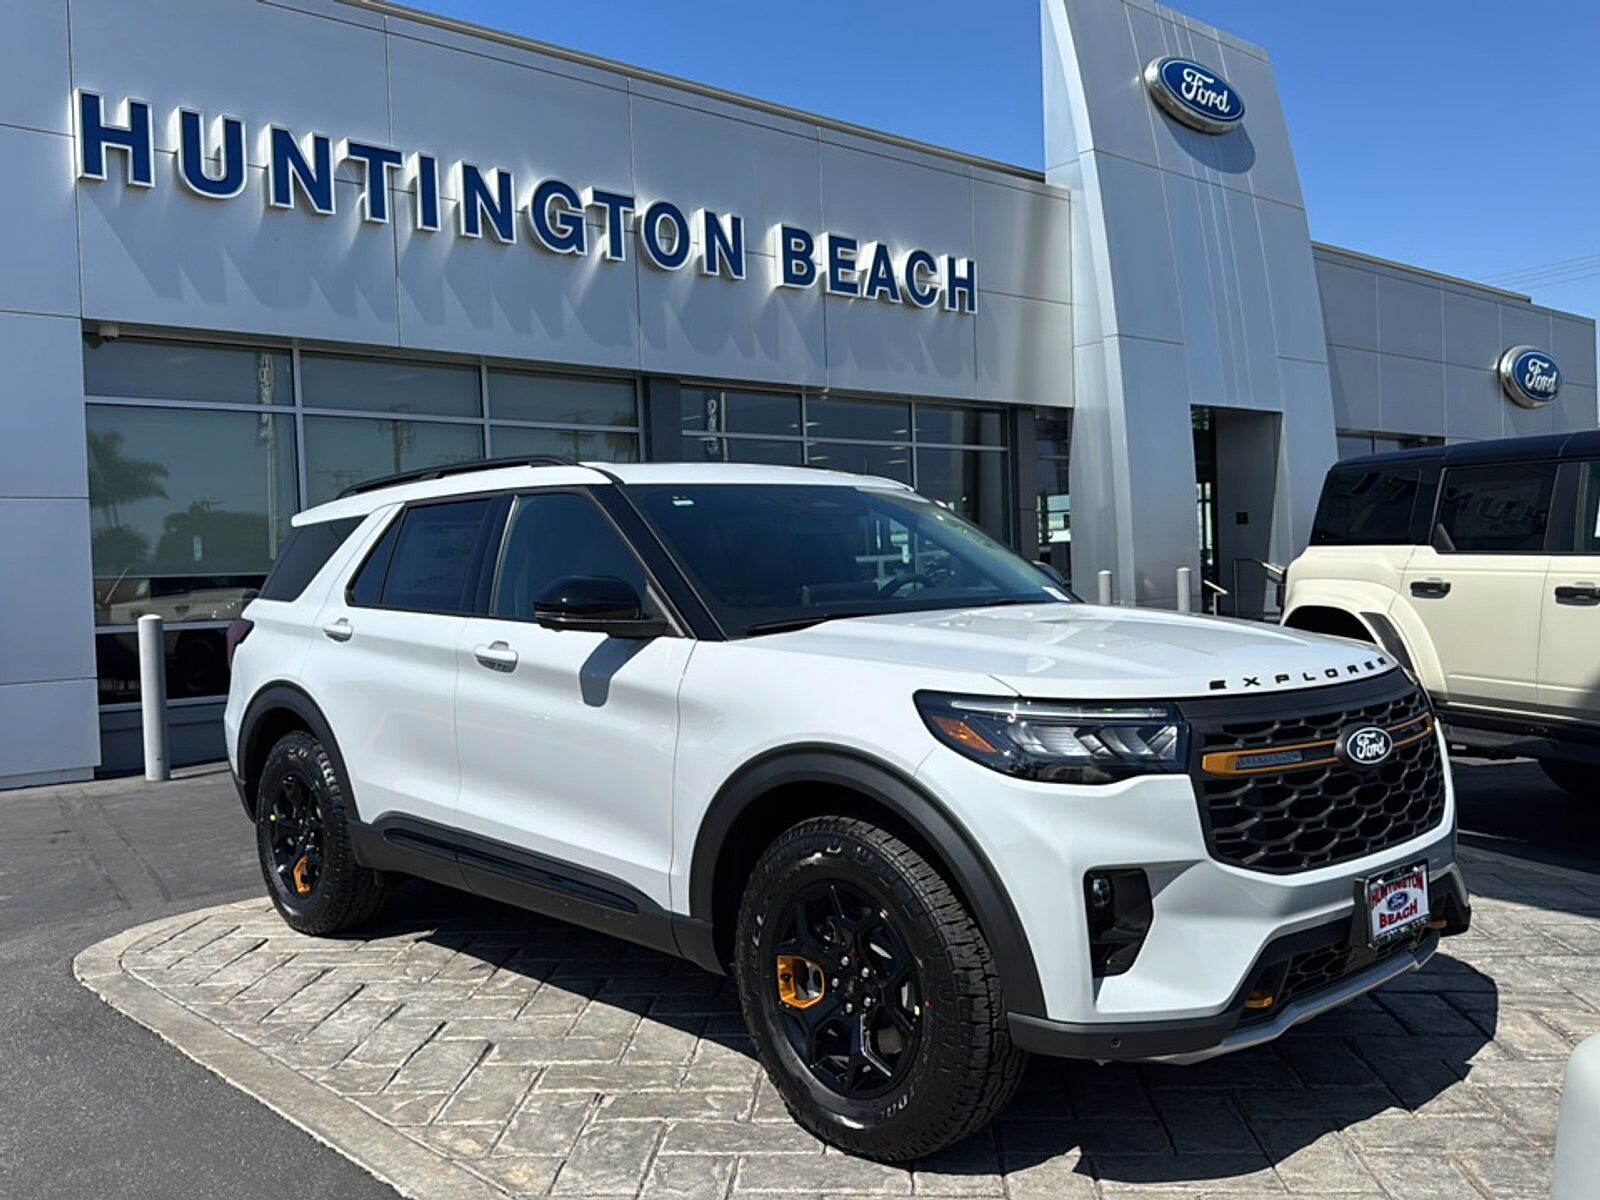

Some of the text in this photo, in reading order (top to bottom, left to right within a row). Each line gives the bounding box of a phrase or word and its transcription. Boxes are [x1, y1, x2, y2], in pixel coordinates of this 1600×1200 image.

[1181, 67, 1231, 114] Ford
[77, 89, 978, 314] HUNTINGTON BEACH
[1525, 358, 1558, 393] Ford
[1209, 656, 1386, 690] EXPLORER
[1356, 733, 1386, 760] Ford
[1379, 898, 1418, 929] BEACH
